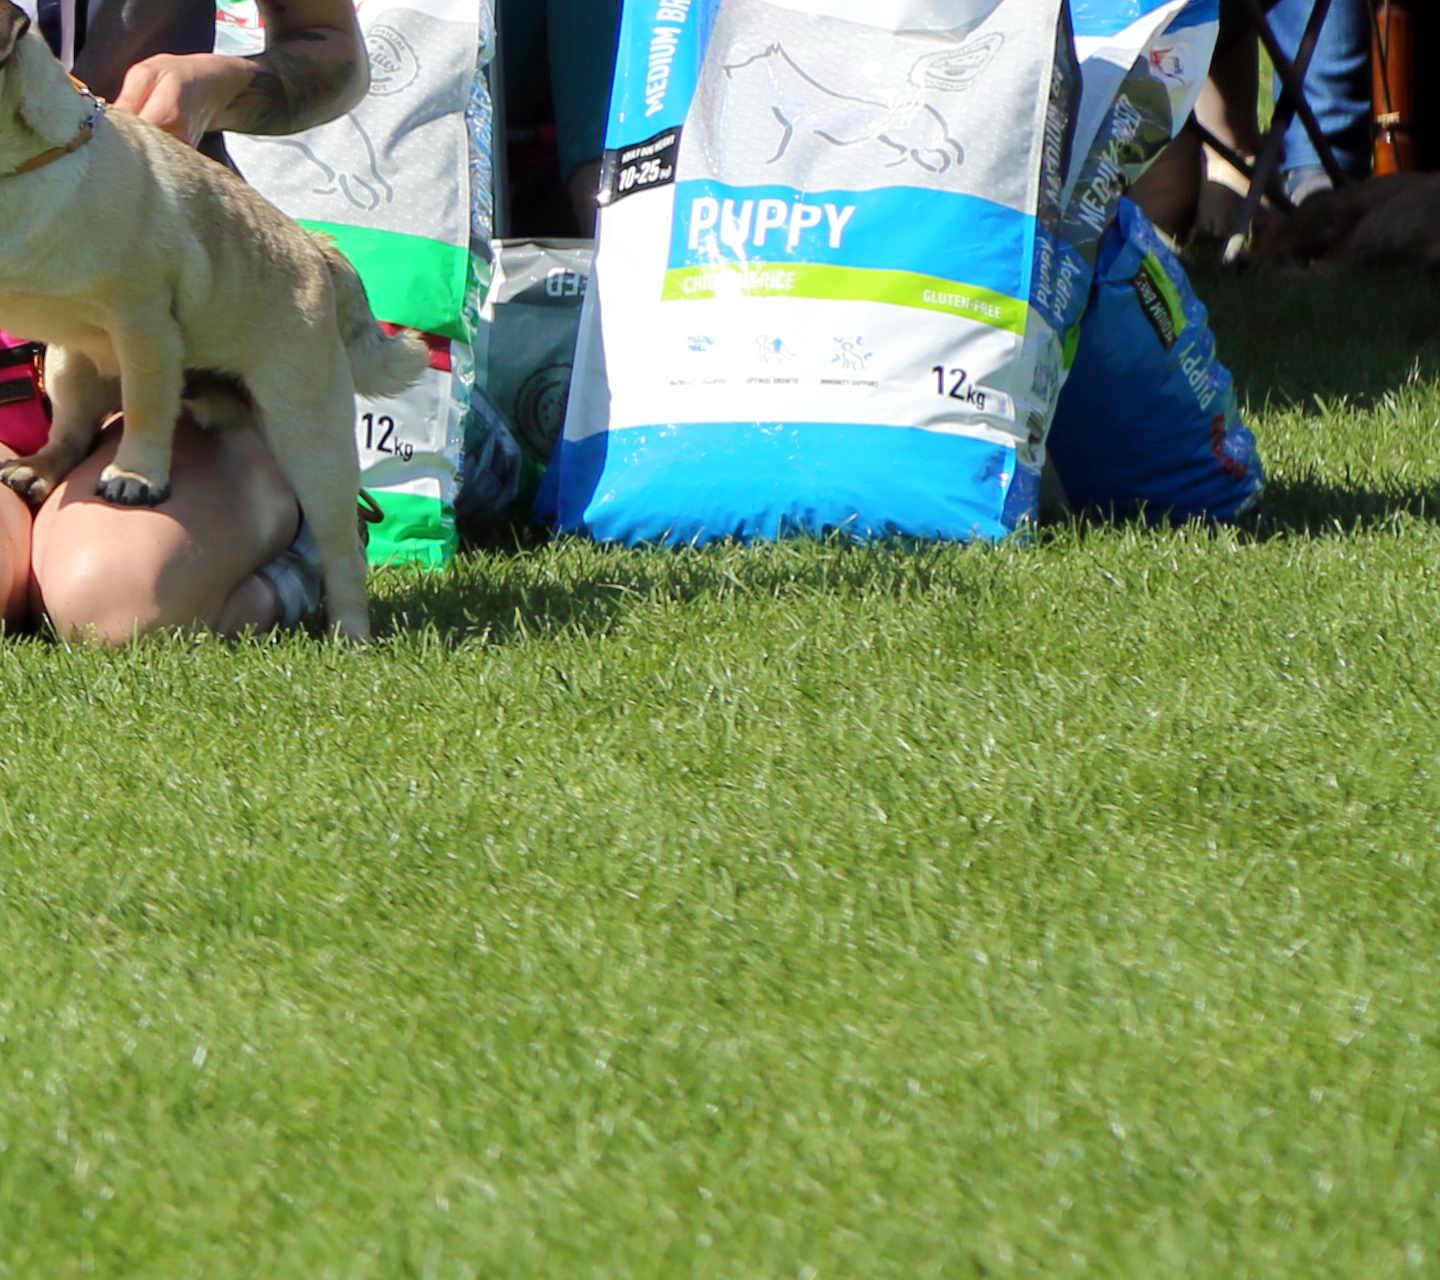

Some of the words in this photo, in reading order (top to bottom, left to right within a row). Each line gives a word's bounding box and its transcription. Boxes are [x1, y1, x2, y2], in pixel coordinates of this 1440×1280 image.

[645, 27, 680, 118] MEDIUM
[619, 159, 661, 192] 10-25
[687, 197, 856, 252] PUPPY
[922, 288, 1002, 319] GLUTEN-FREE
[1179, 342, 1216, 411] PUPPY
